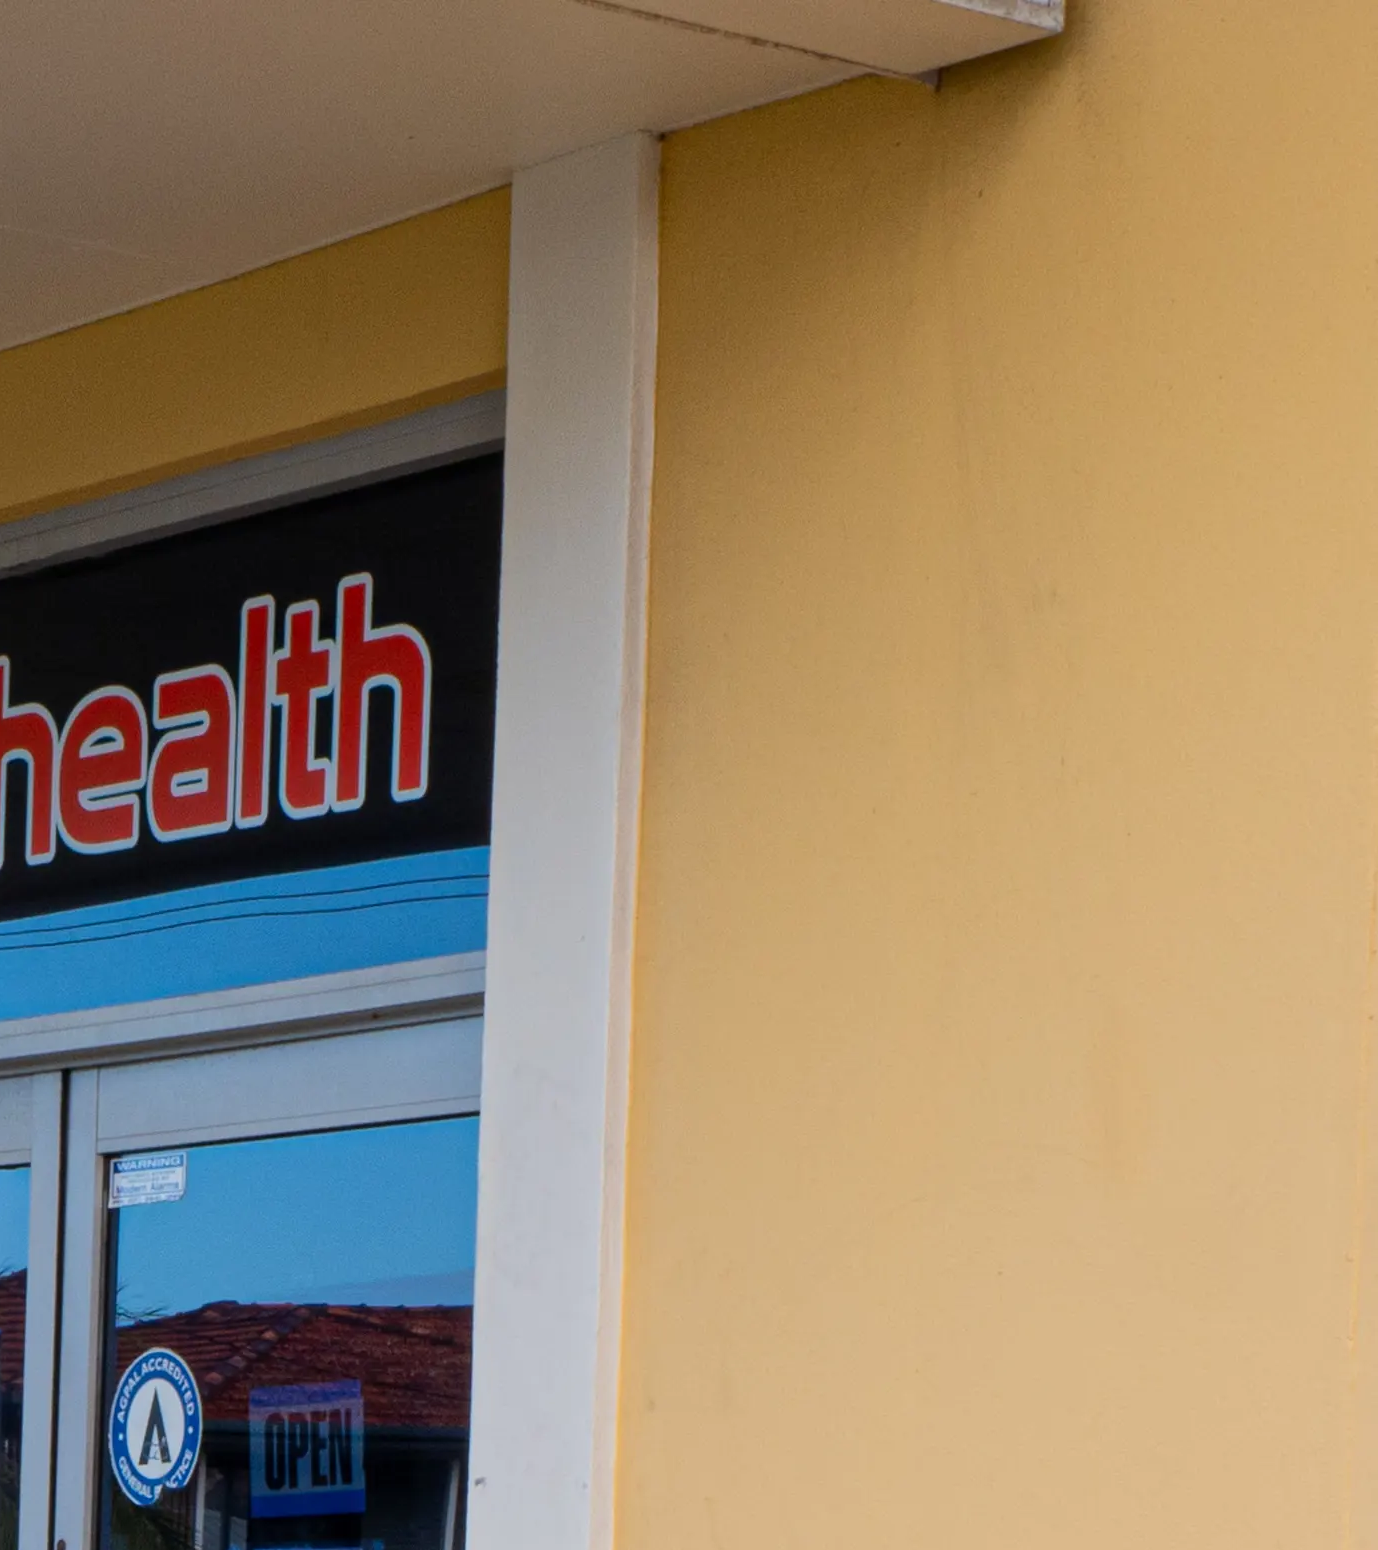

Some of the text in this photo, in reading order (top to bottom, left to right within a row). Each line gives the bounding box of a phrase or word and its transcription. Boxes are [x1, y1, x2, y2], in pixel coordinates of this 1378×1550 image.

[117, 1155, 180, 1171] WARNING
[117, 1357, 195, 1423] AGPAL ACCREDITED
[264, 1408, 353, 1490] OPEN
[118, 1456, 153, 1498] GENERAL
